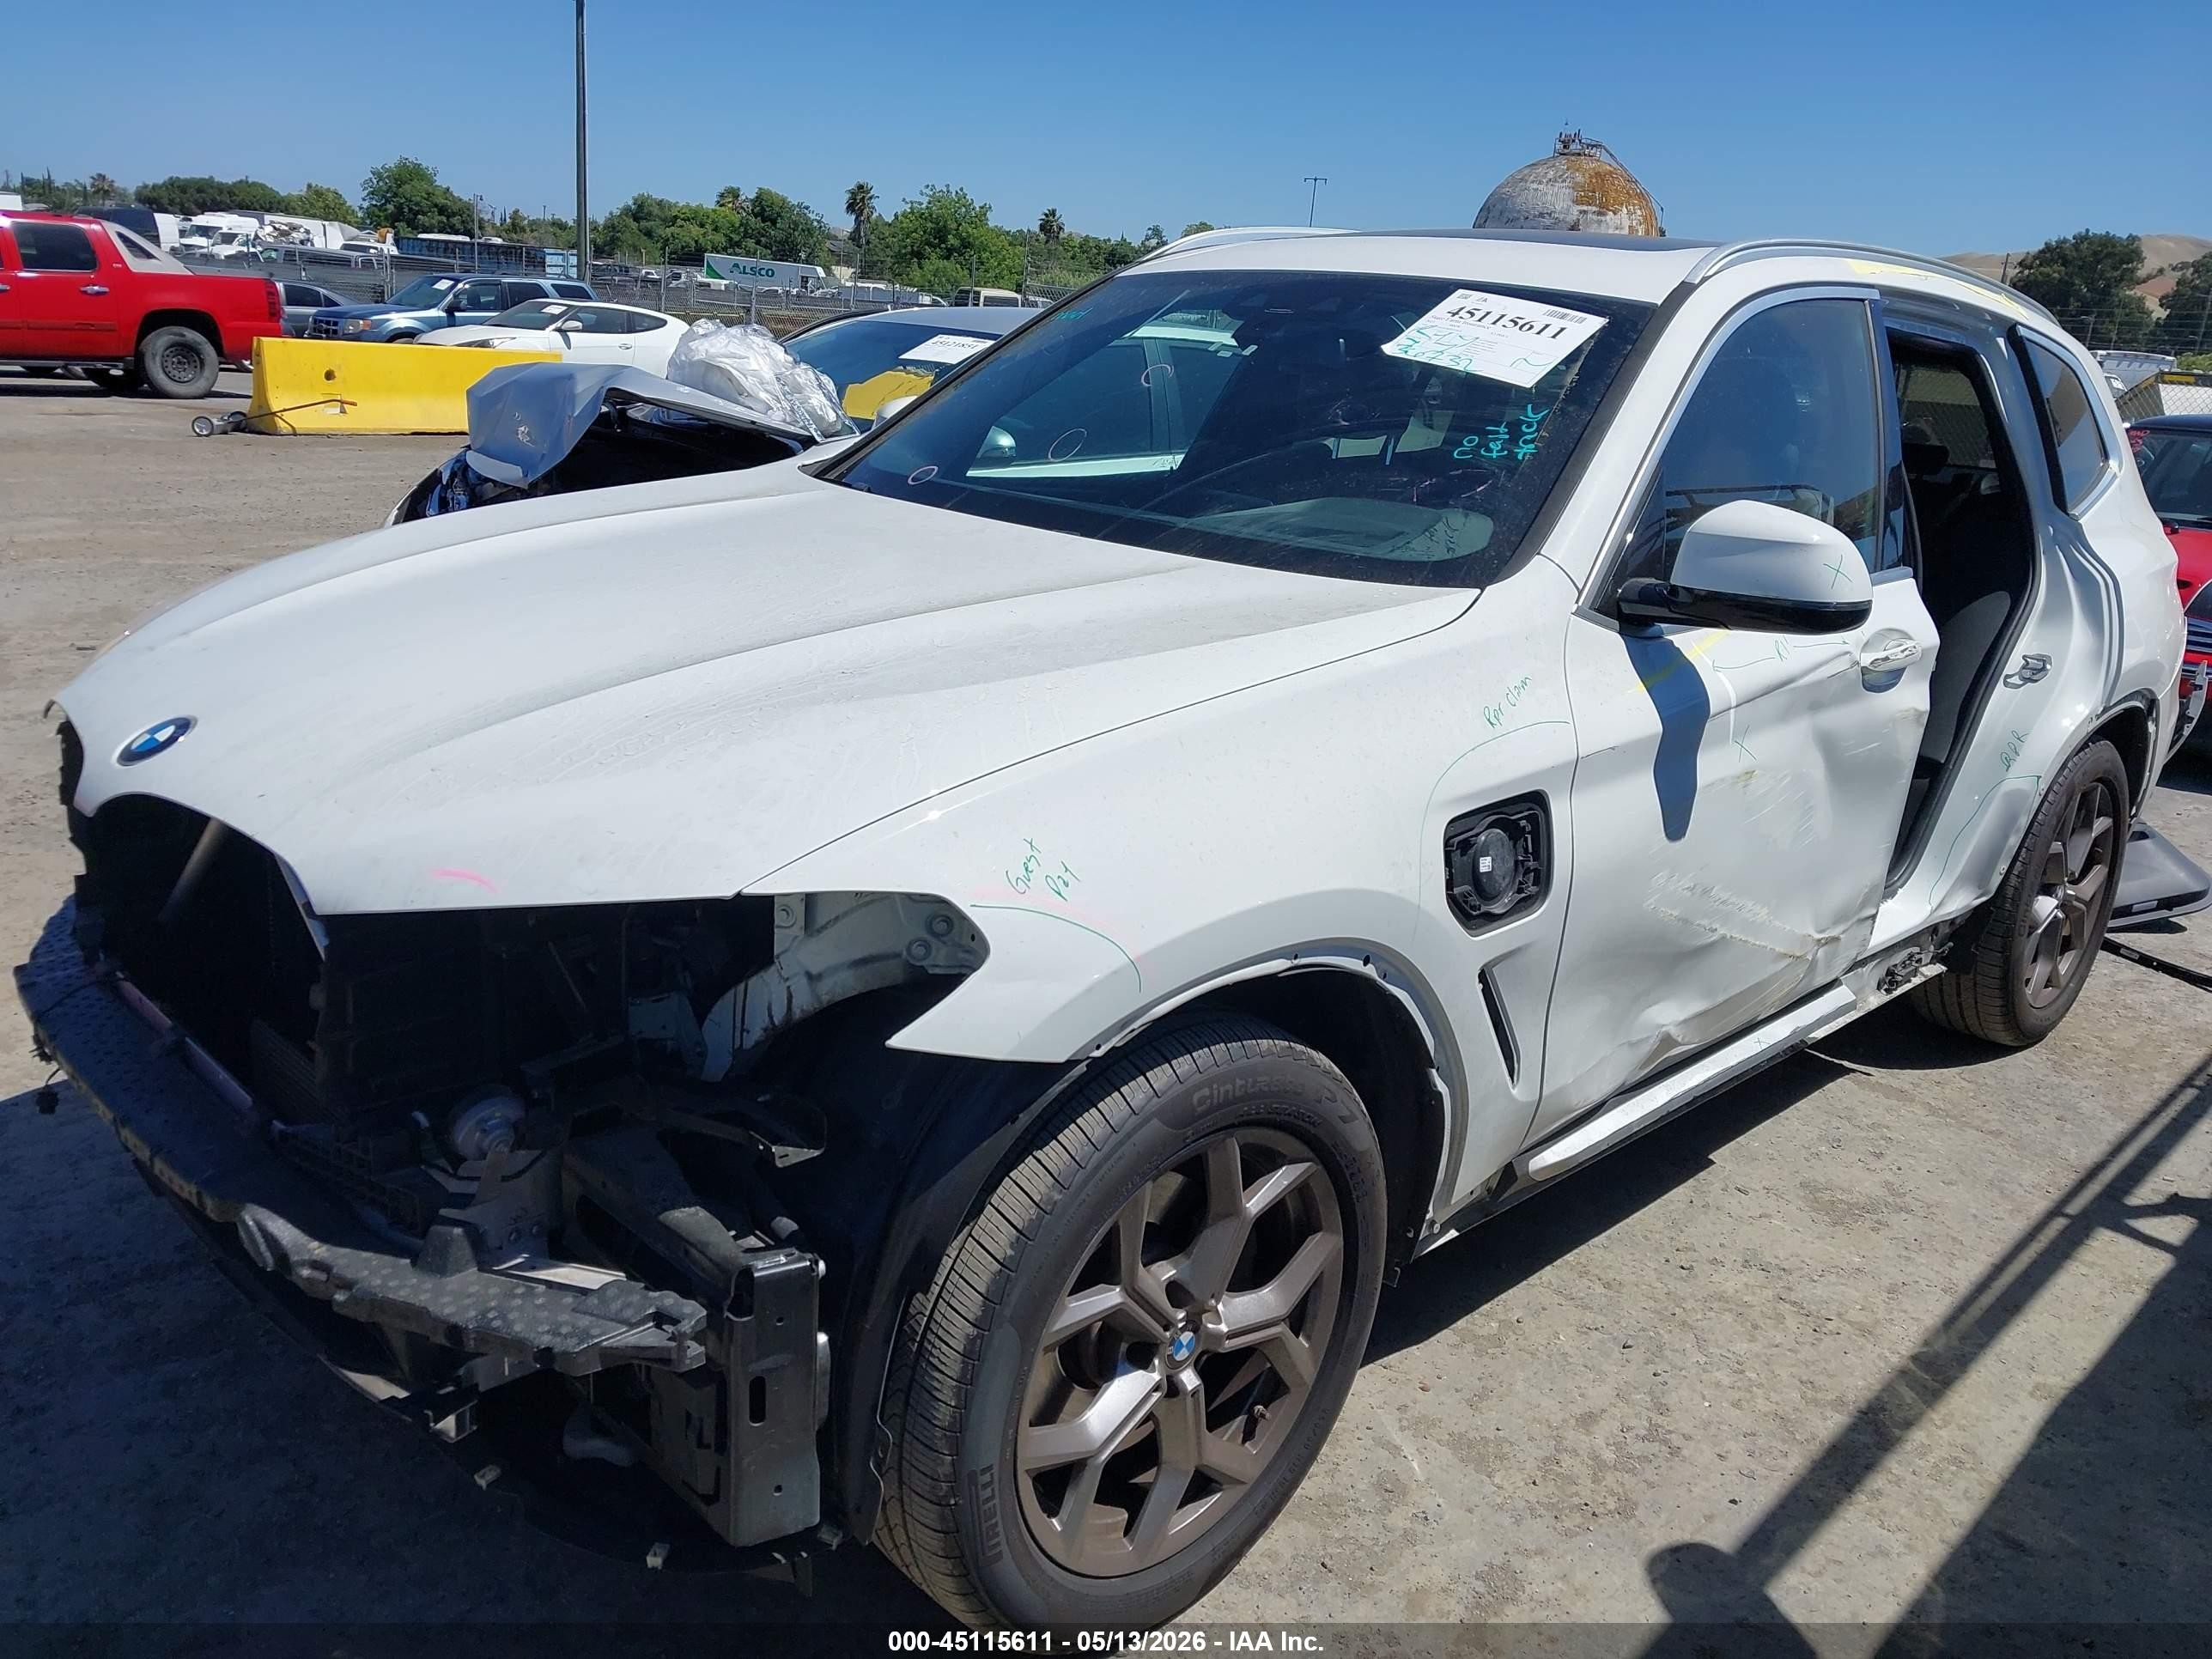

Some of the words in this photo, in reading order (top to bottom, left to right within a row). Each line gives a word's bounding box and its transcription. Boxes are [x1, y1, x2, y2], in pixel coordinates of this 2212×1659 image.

[730, 263, 775, 278] ALSCO
[1447, 306, 1567, 339] 45115611
[967, 1462, 1005, 1567] PIRELLI
